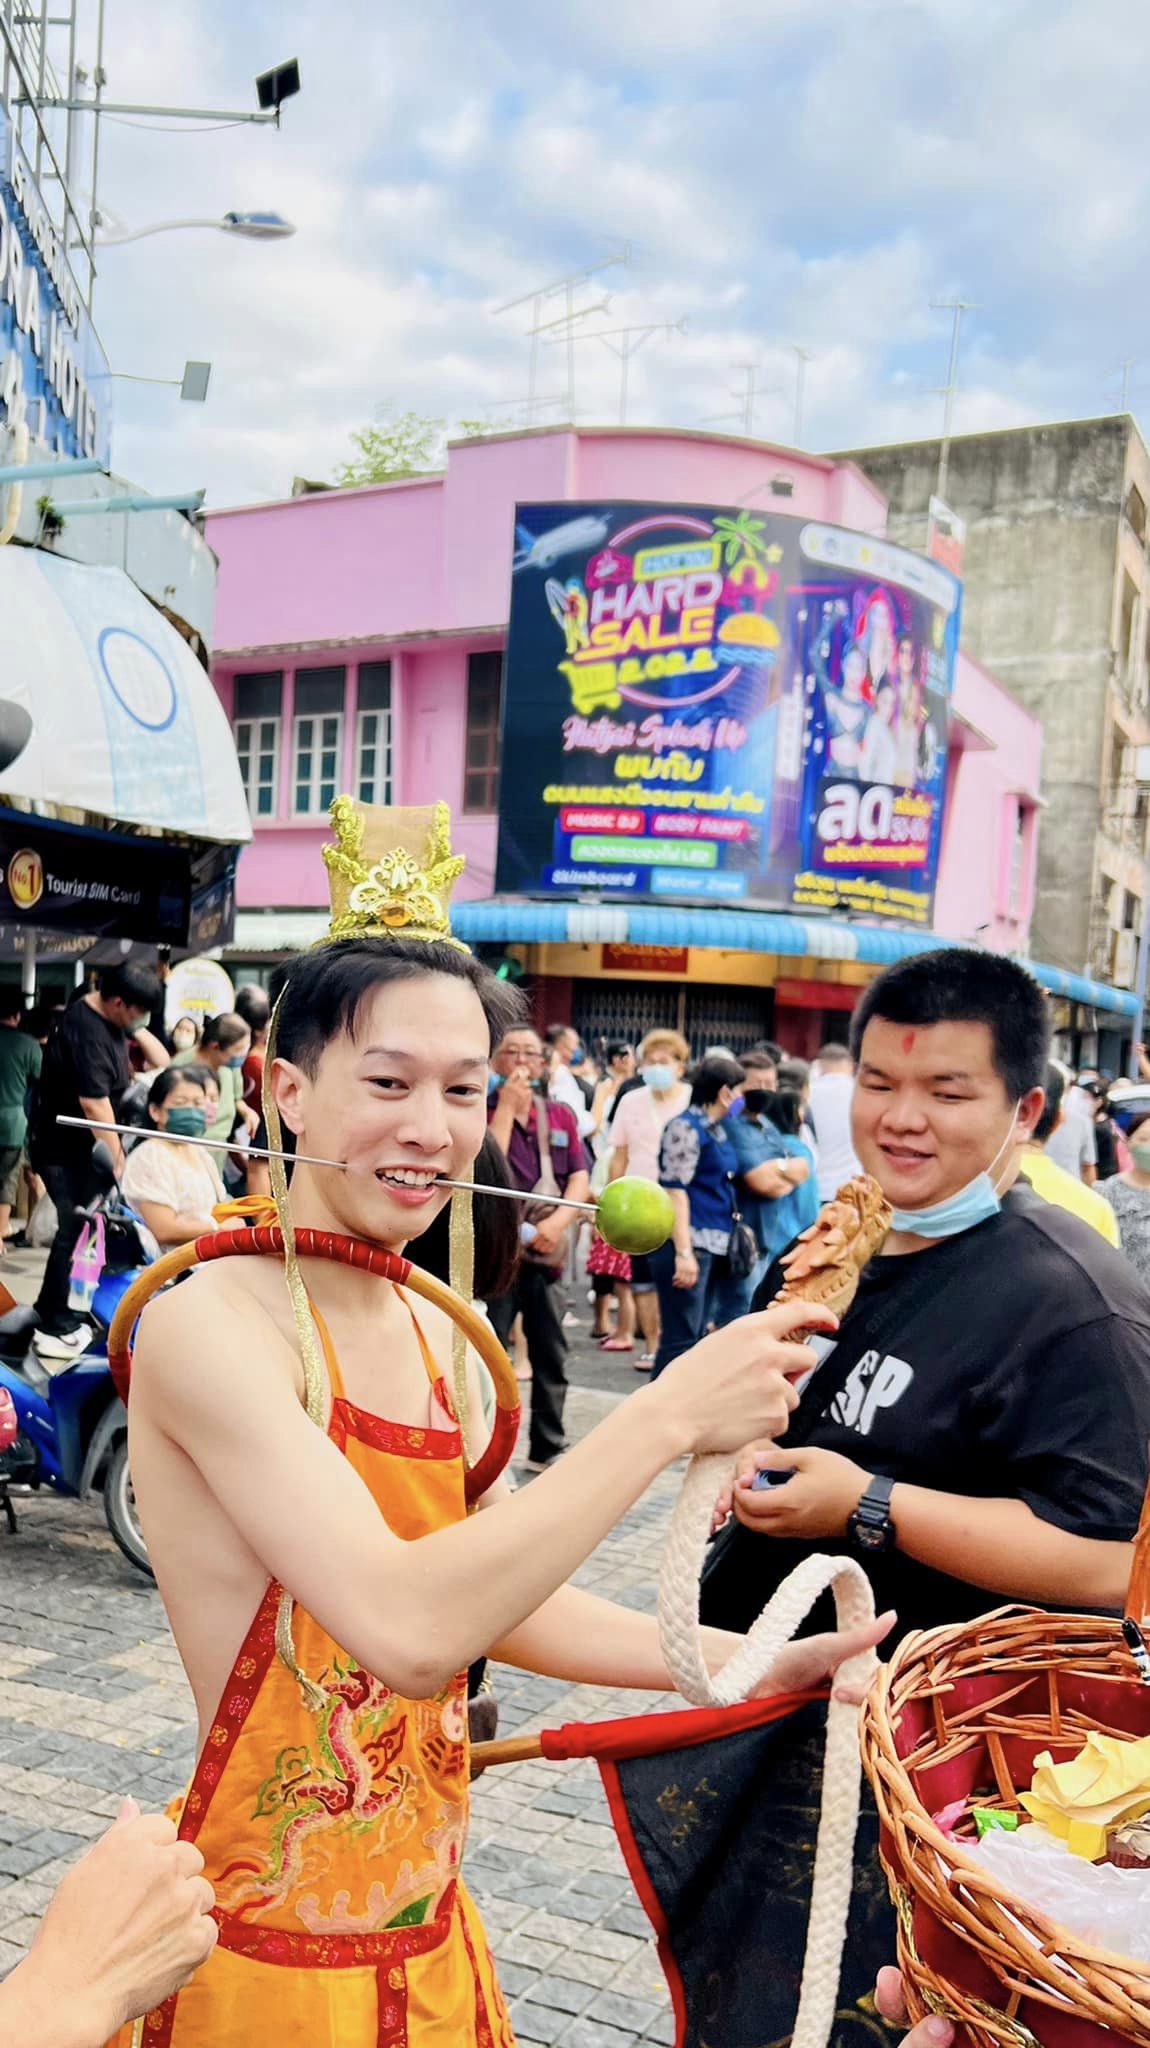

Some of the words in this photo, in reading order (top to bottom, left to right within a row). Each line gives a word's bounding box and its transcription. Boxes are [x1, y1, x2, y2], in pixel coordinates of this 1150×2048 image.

[591, 572, 723, 623] HARD
[574, 606, 716, 662] SALE
[614, 751, 705, 782] พบกับ
[566, 813, 615, 828] MUSIC
[617, 815, 640, 830] DJ
[654, 815, 699, 832] BODY
[701, 817, 743, 837] PAINT
[817, 783, 893, 841] ลด
[46, 873, 88, 898] Tourist
[88, 882, 110, 900] SIM
[111, 886, 141, 904] Card
